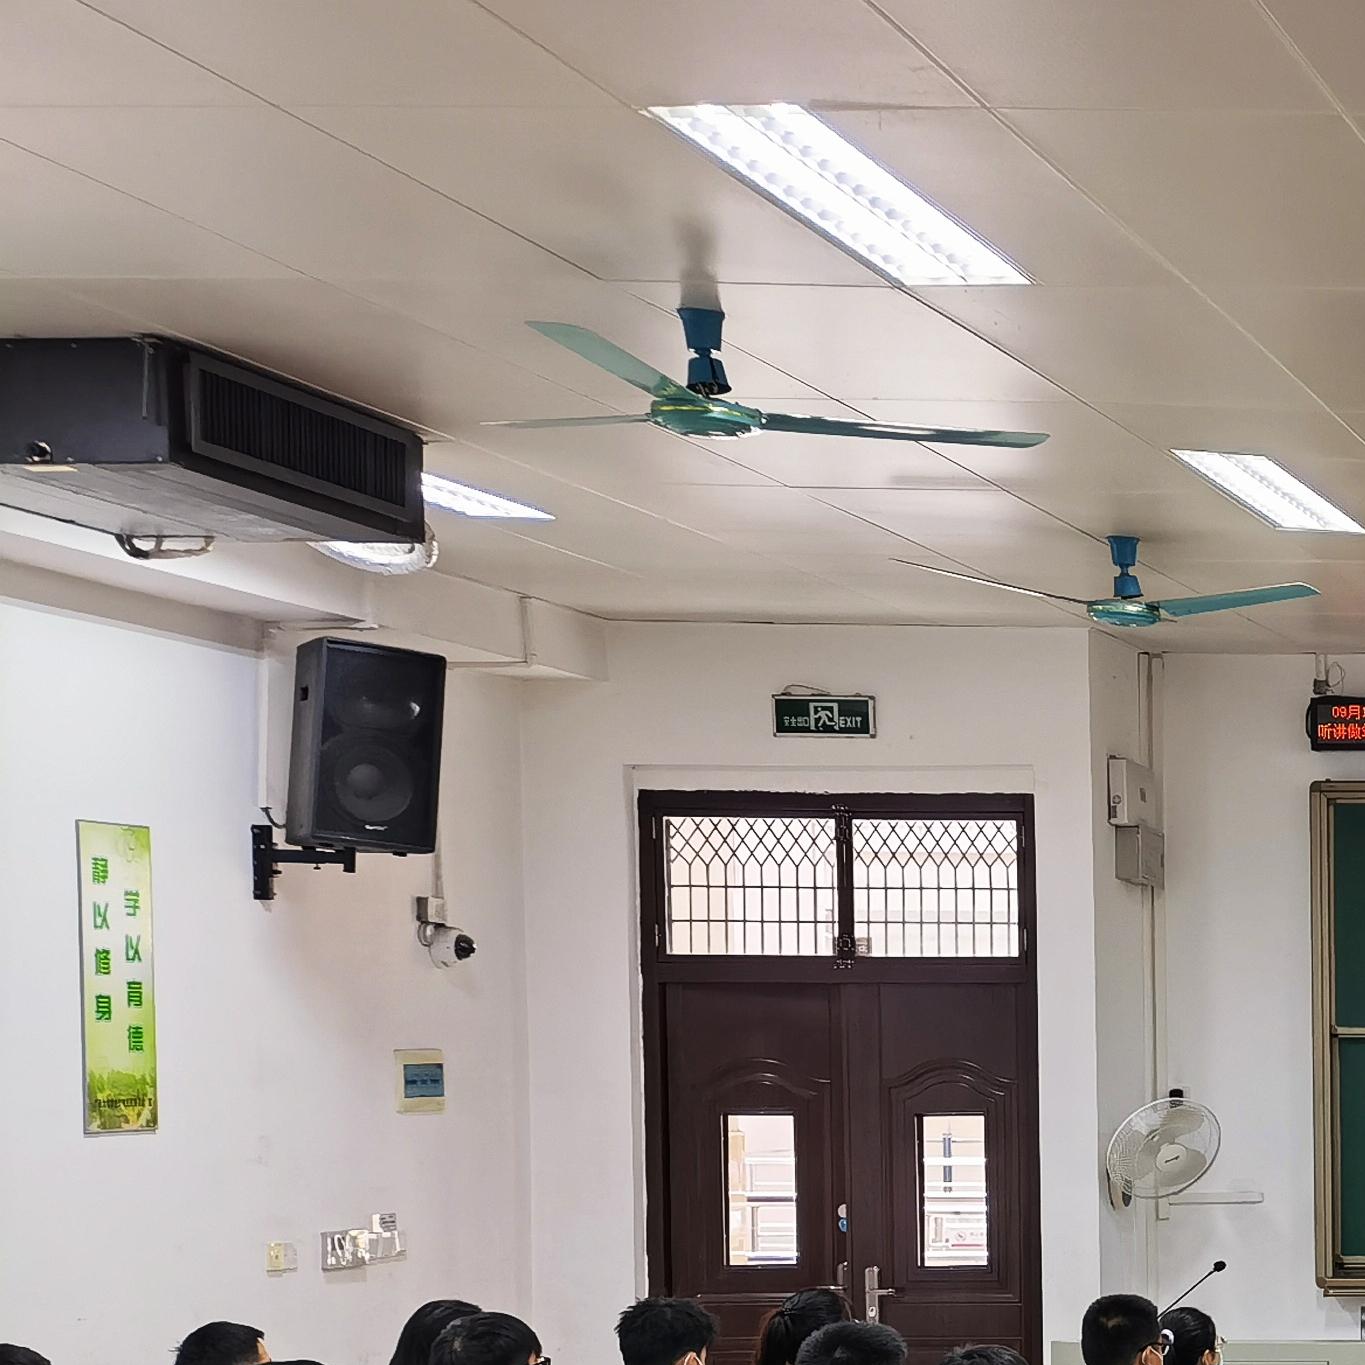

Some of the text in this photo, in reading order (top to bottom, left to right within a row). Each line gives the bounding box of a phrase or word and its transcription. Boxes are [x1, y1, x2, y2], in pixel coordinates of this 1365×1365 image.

[839, 716, 862, 728] EXIT
[92, 856, 112, 1023] 静以修身
